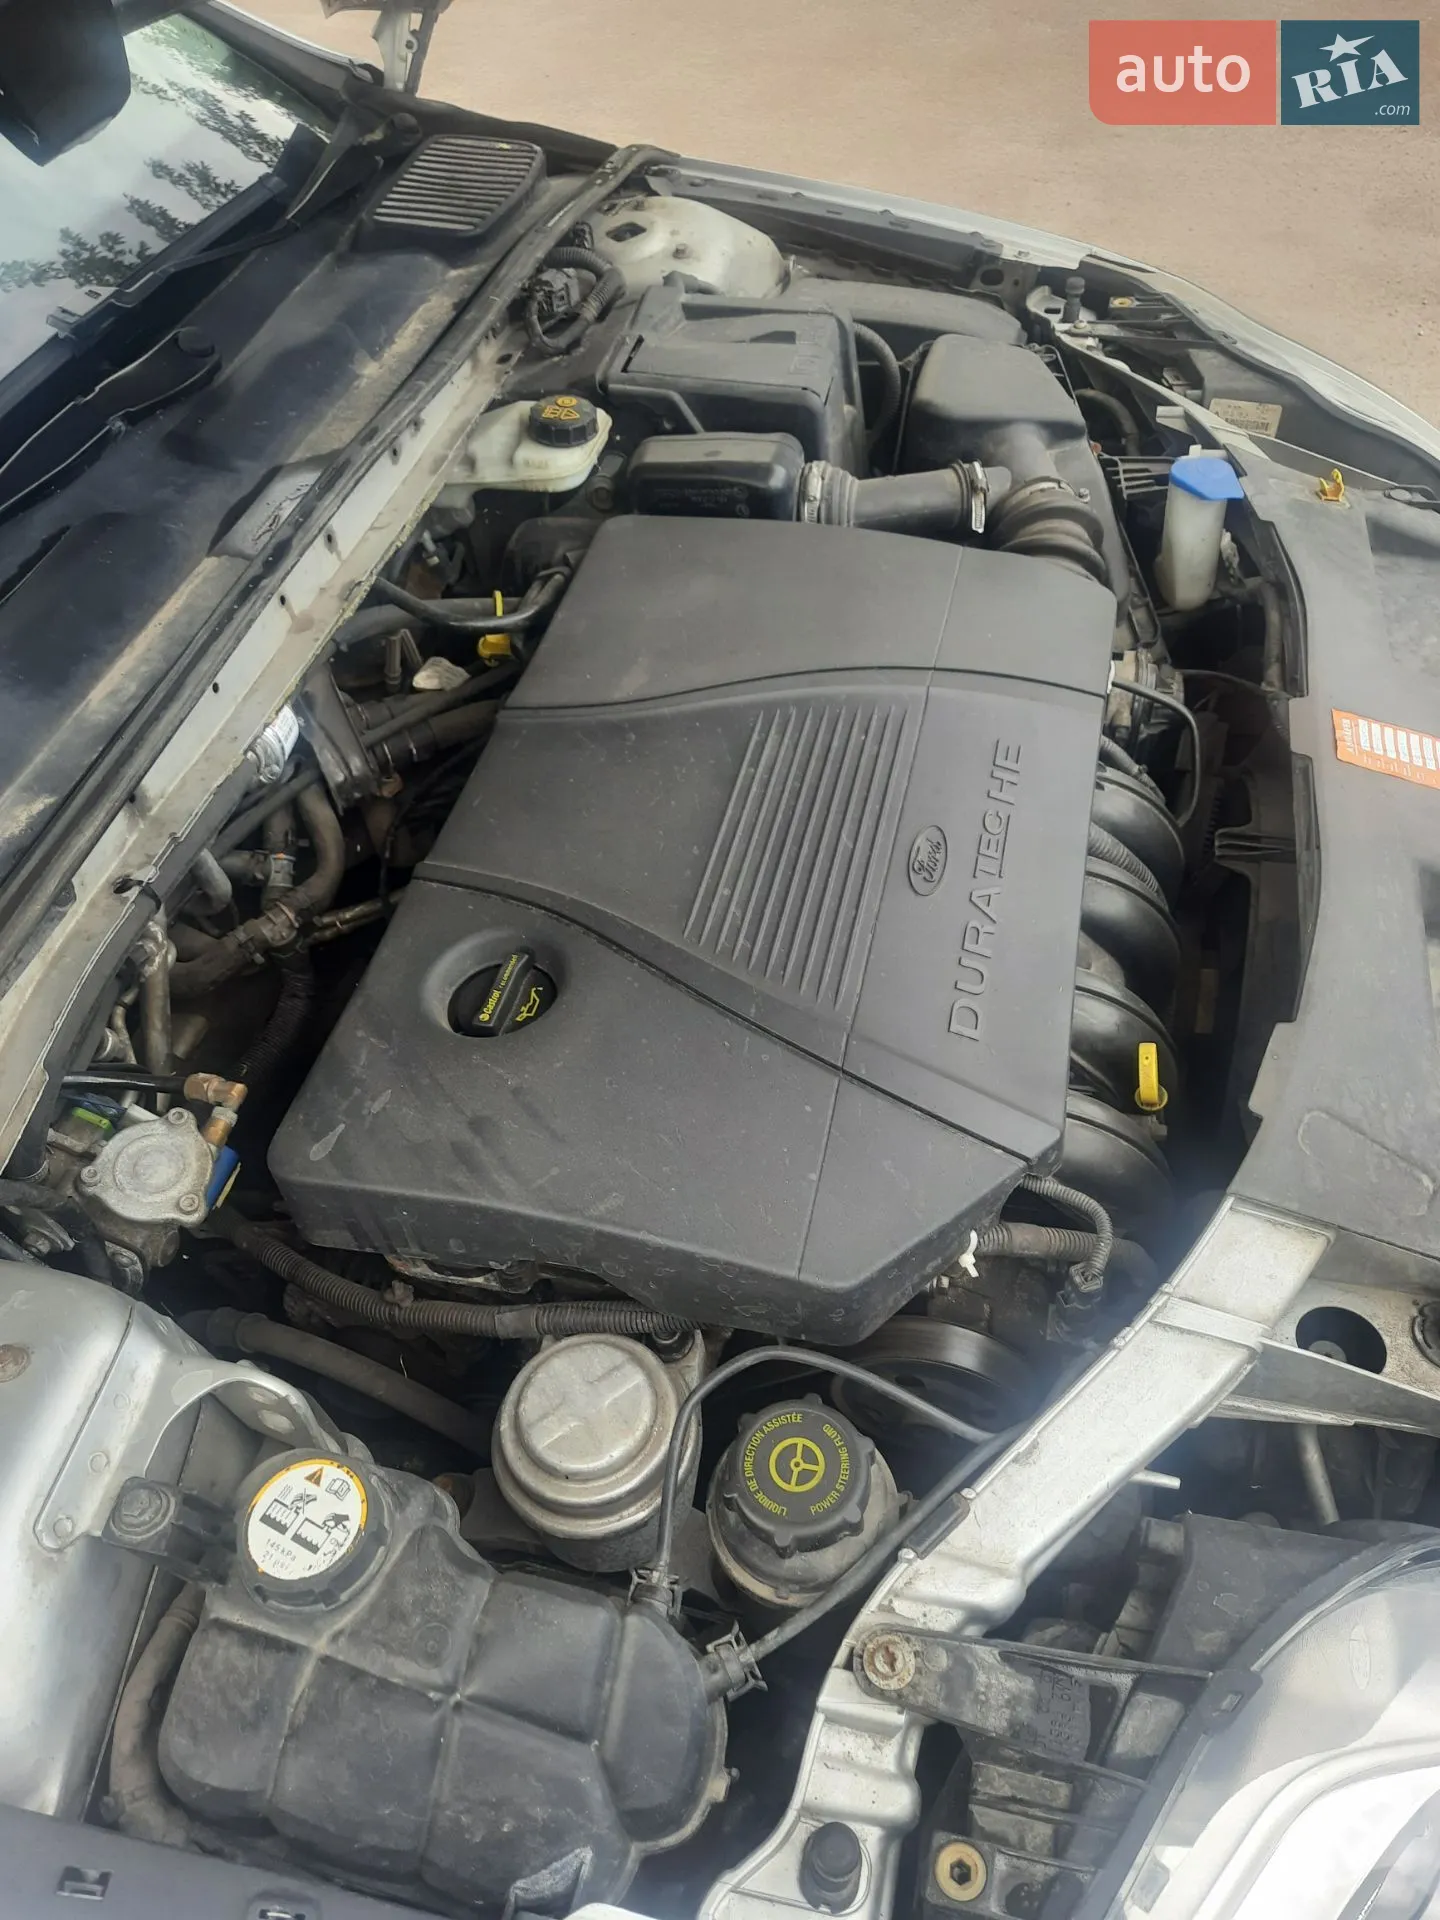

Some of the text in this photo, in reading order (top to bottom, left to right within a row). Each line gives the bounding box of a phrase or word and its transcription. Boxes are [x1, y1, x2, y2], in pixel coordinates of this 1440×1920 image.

[911, 837, 942, 884] Ford
[483, 989, 502, 1015] Castrol
[743, 1411, 803, 1517] LIQUIDE DE DIRECTION ASSISTÉE
[810, 1423, 850, 1517] POWER STEERING FLUID
